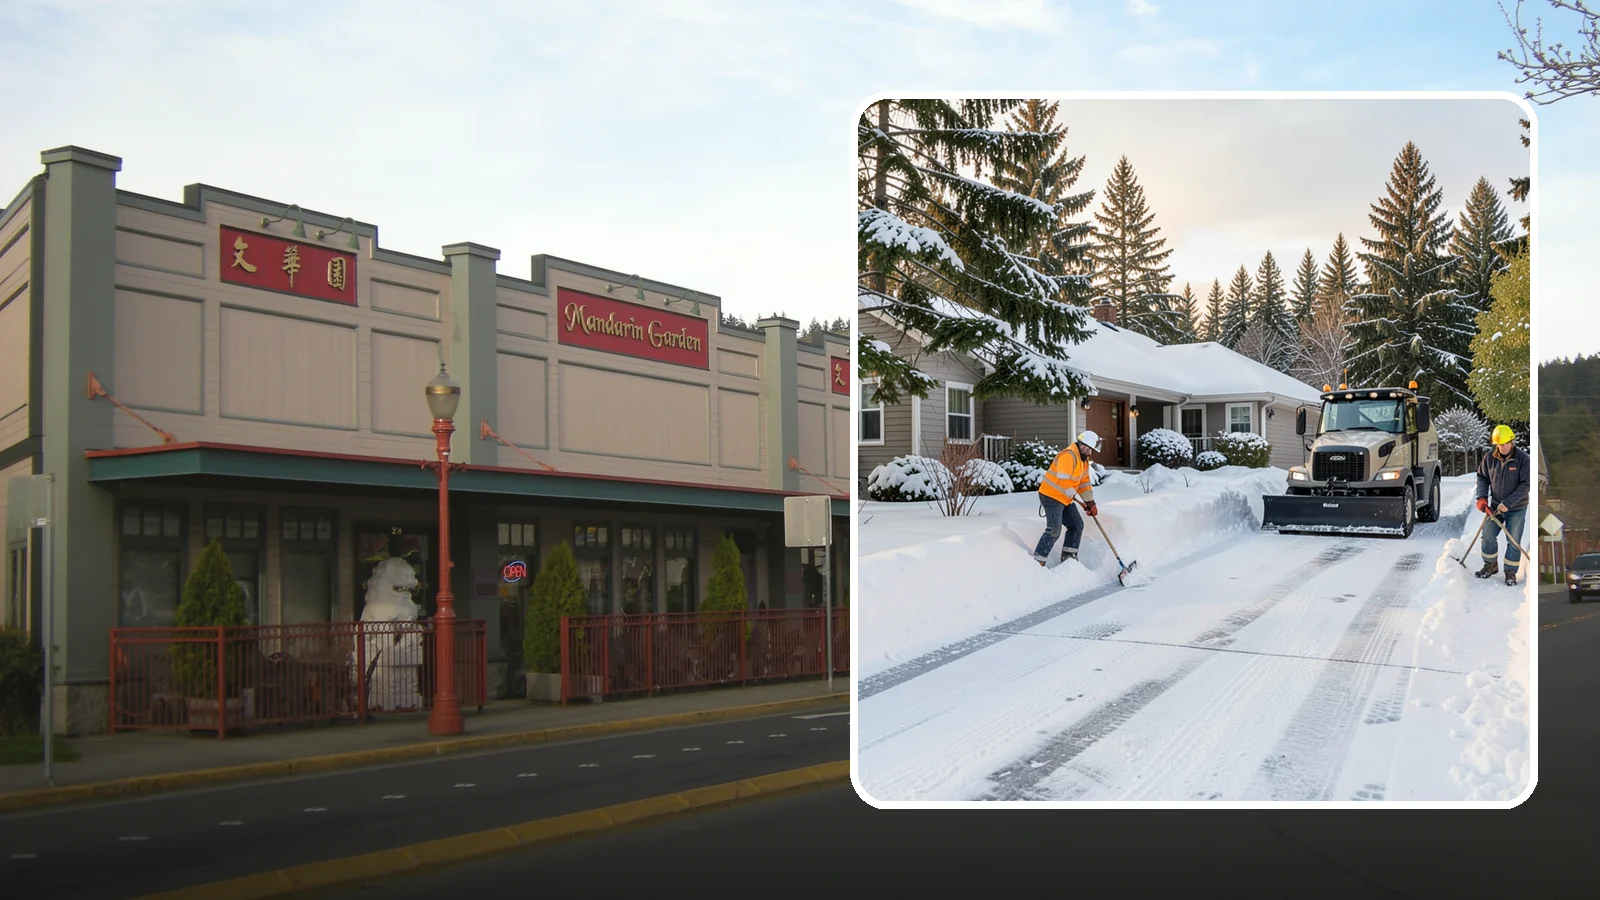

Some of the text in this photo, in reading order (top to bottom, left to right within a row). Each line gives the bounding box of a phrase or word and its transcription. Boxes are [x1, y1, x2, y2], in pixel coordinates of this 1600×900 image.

[231, 236, 346, 291] 文華園
[564, 302, 702, 352] Mandarin Garden
[834, 363, 847, 386] 文
[503, 565, 527, 578] OPEN
